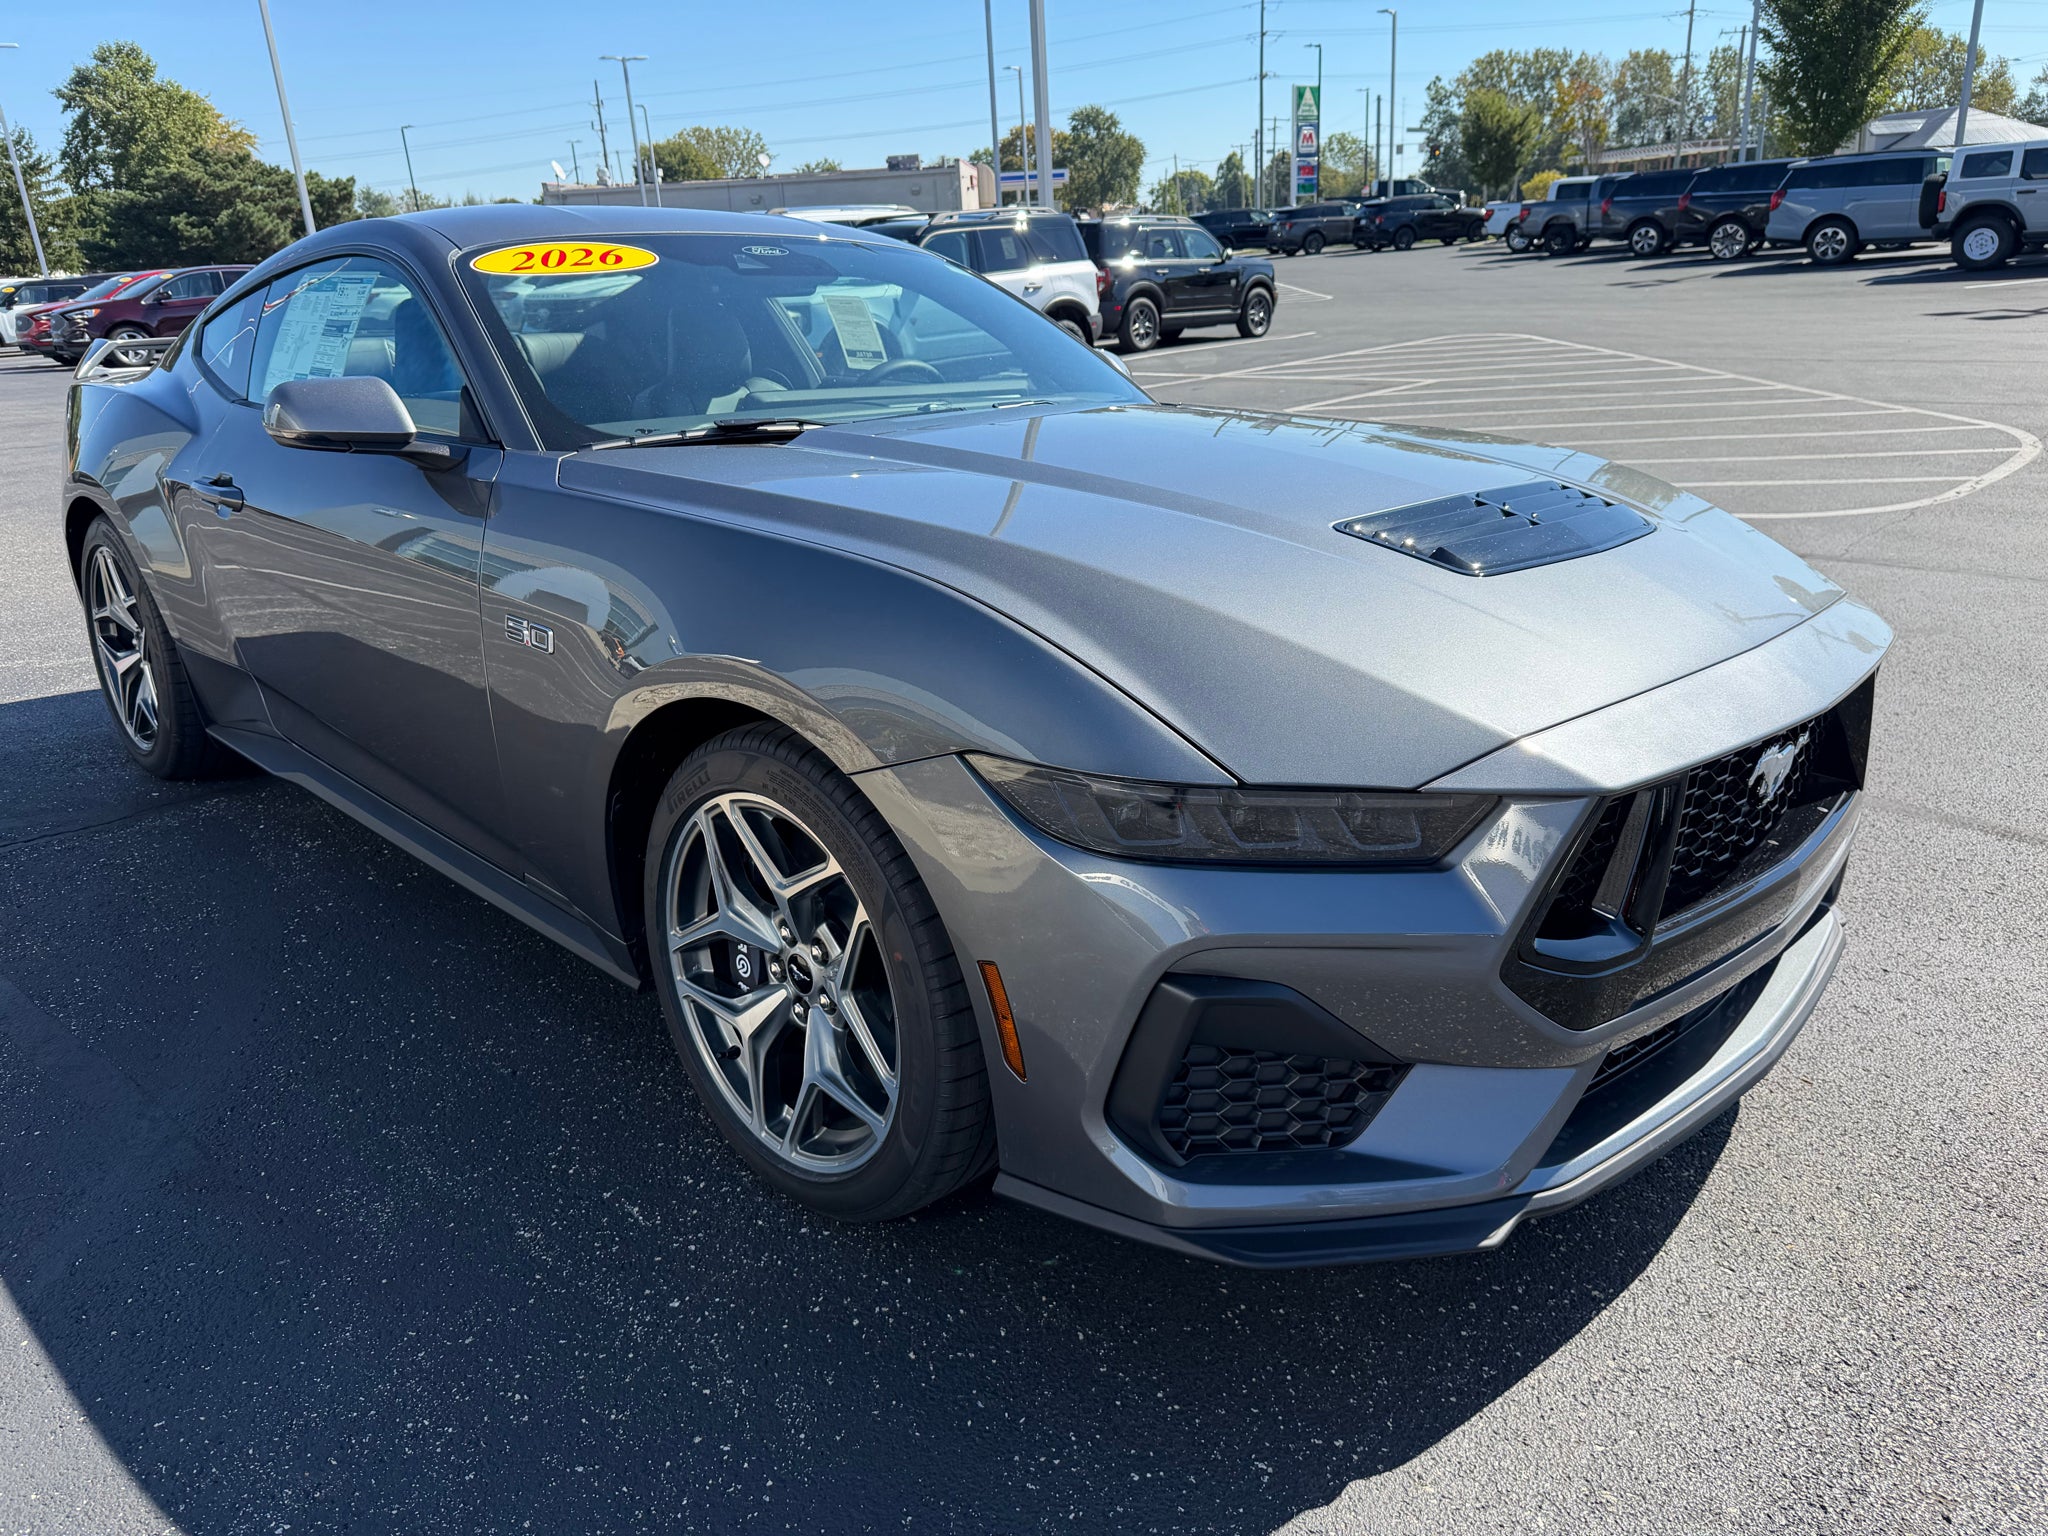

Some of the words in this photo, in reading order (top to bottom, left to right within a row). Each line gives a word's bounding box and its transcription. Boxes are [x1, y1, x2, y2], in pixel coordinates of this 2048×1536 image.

[1302, 133, 1314, 144] M
[509, 247, 625, 272] 2026
[750, 246, 783, 255] Ford
[504, 613, 556, 656] 5.0
[667, 761, 711, 813] PIRELLI
